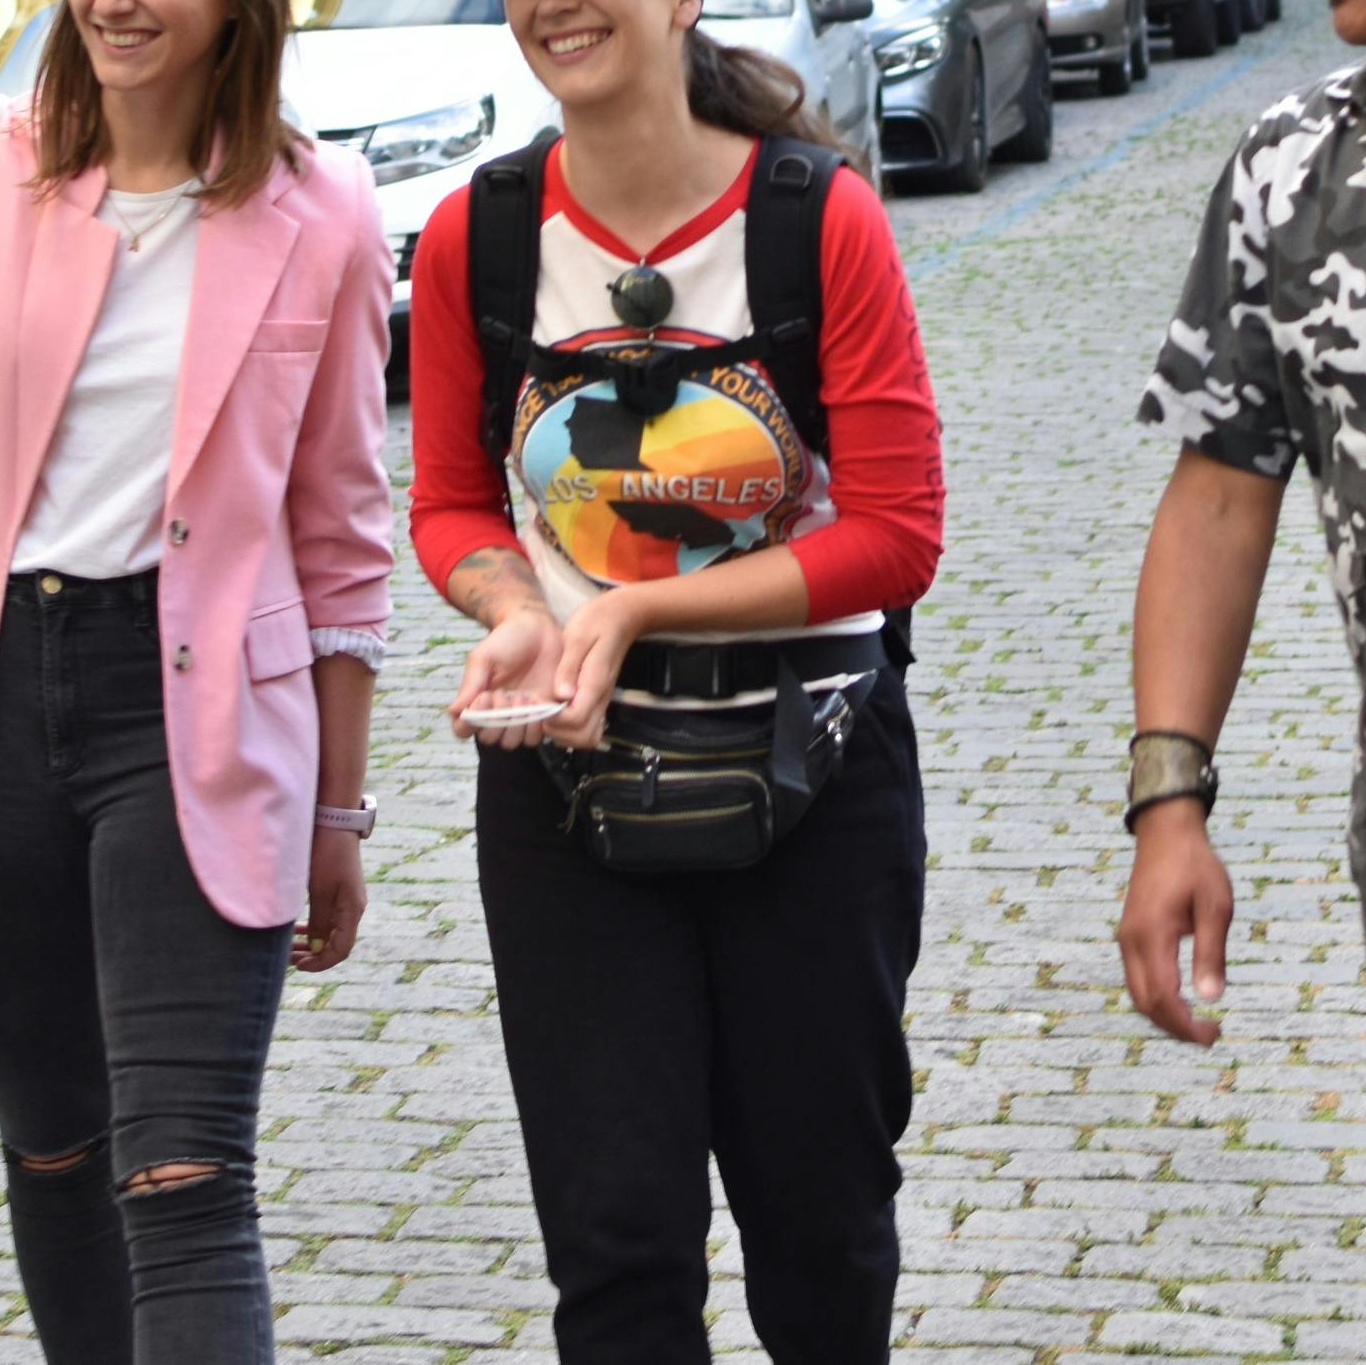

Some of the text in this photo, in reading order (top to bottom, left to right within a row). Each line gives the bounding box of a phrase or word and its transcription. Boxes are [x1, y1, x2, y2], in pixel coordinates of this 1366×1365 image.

[709, 366, 772, 417] YOUR
[543, 473, 782, 504] LOS ANGELES
